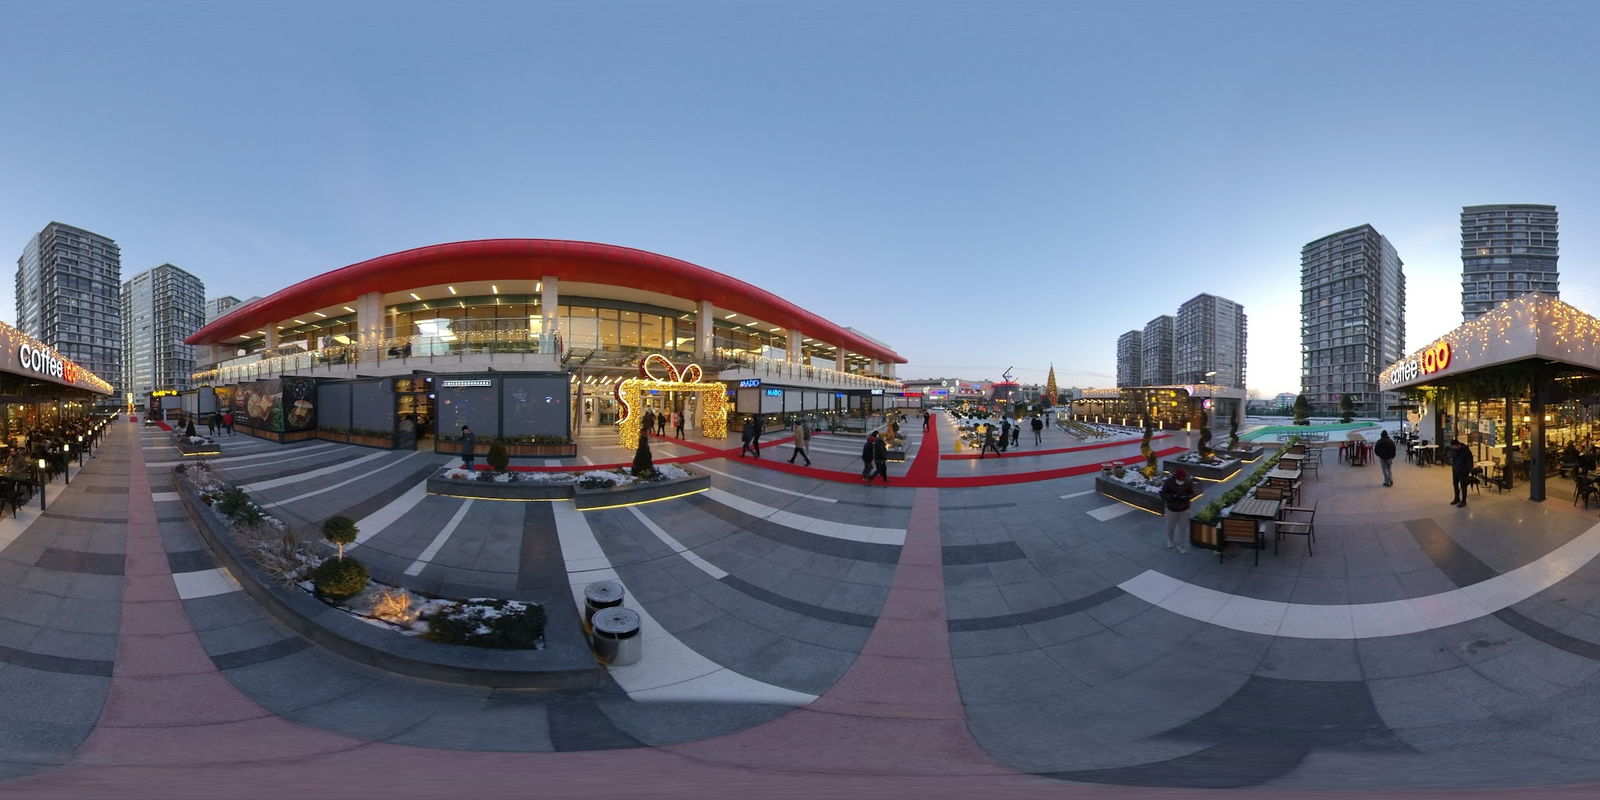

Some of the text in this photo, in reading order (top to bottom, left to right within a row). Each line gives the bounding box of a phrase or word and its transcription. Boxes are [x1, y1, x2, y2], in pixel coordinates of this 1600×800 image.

[20, 344, 63, 378] coffee
[1390, 359, 1418, 385] coffee
[739, 379, 760, 388] MADO
